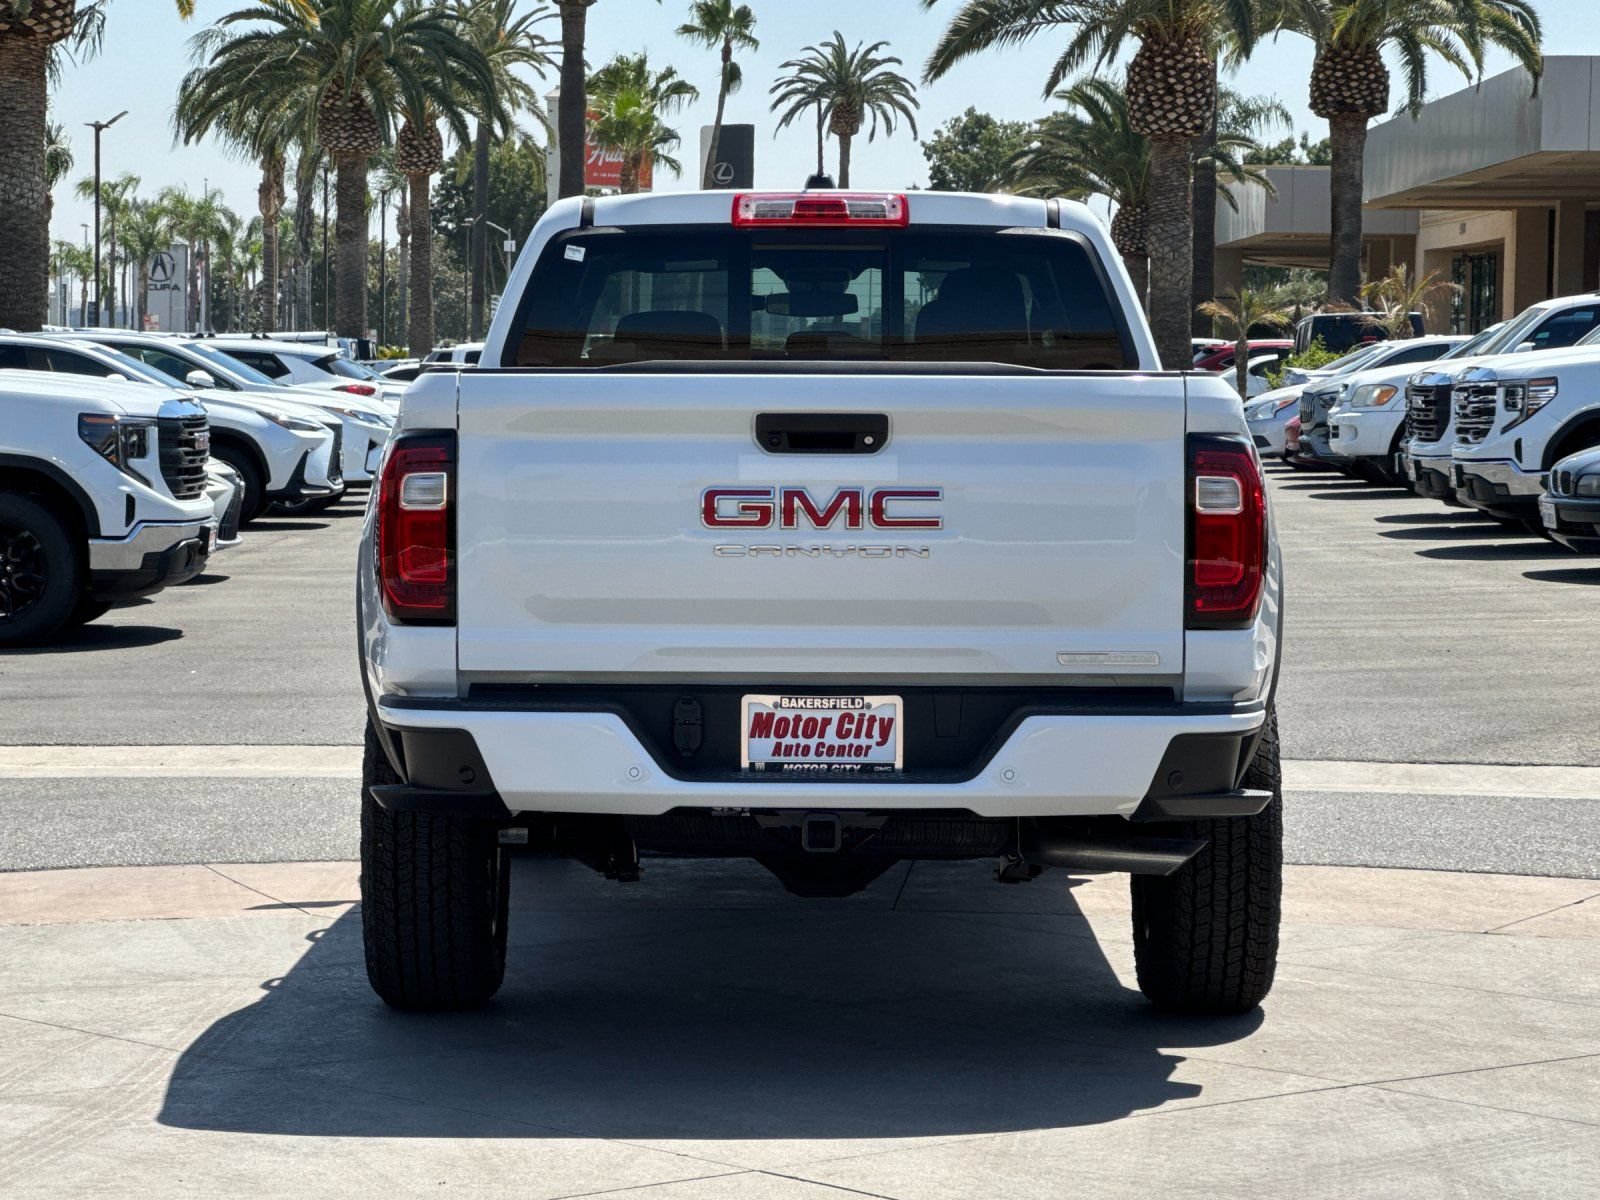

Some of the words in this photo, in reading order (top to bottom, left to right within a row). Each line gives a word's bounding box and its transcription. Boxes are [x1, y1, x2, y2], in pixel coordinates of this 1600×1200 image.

[148, 283, 180, 291] CURA
[701, 486, 944, 530] GMC
[713, 544, 929, 558] CANYON
[781, 697, 863, 709] BAKERSFIELD
[749, 712, 832, 739] Motor
[835, 712, 894, 746] City
[771, 742, 811, 757] Auto
[814, 742, 872, 758] Center
[783, 763, 828, 772] MOTOR
[831, 763, 861, 772] CITY
